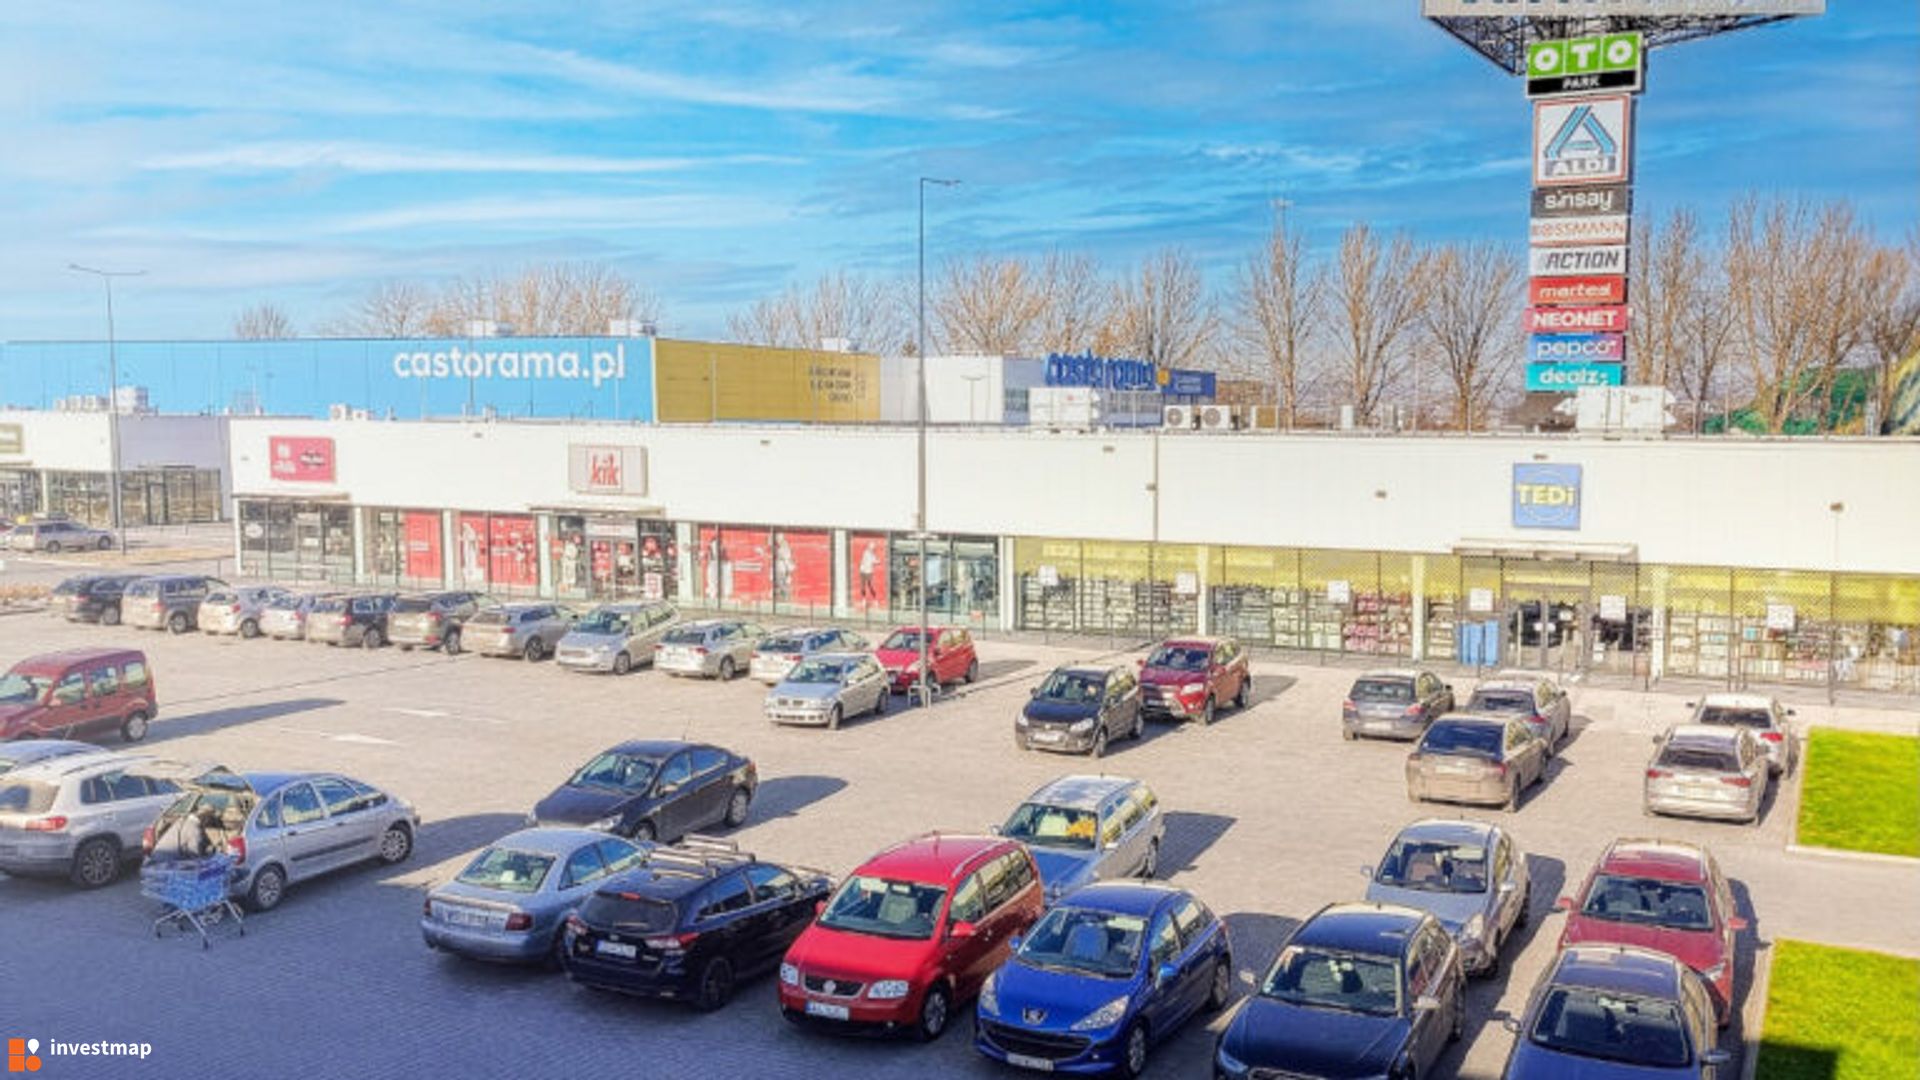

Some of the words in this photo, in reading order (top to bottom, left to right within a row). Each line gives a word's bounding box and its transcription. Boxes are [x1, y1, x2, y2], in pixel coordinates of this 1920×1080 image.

[1534, 39, 1632, 71] OTO
[1562, 75, 1599, 89] PARK
[1552, 157, 1611, 176] ALDI
[1544, 189, 1614, 211] sinsay
[1545, 250, 1619, 270] ACTION
[1532, 310, 1618, 328] NEONET
[393, 342, 625, 388] castorama.pl
